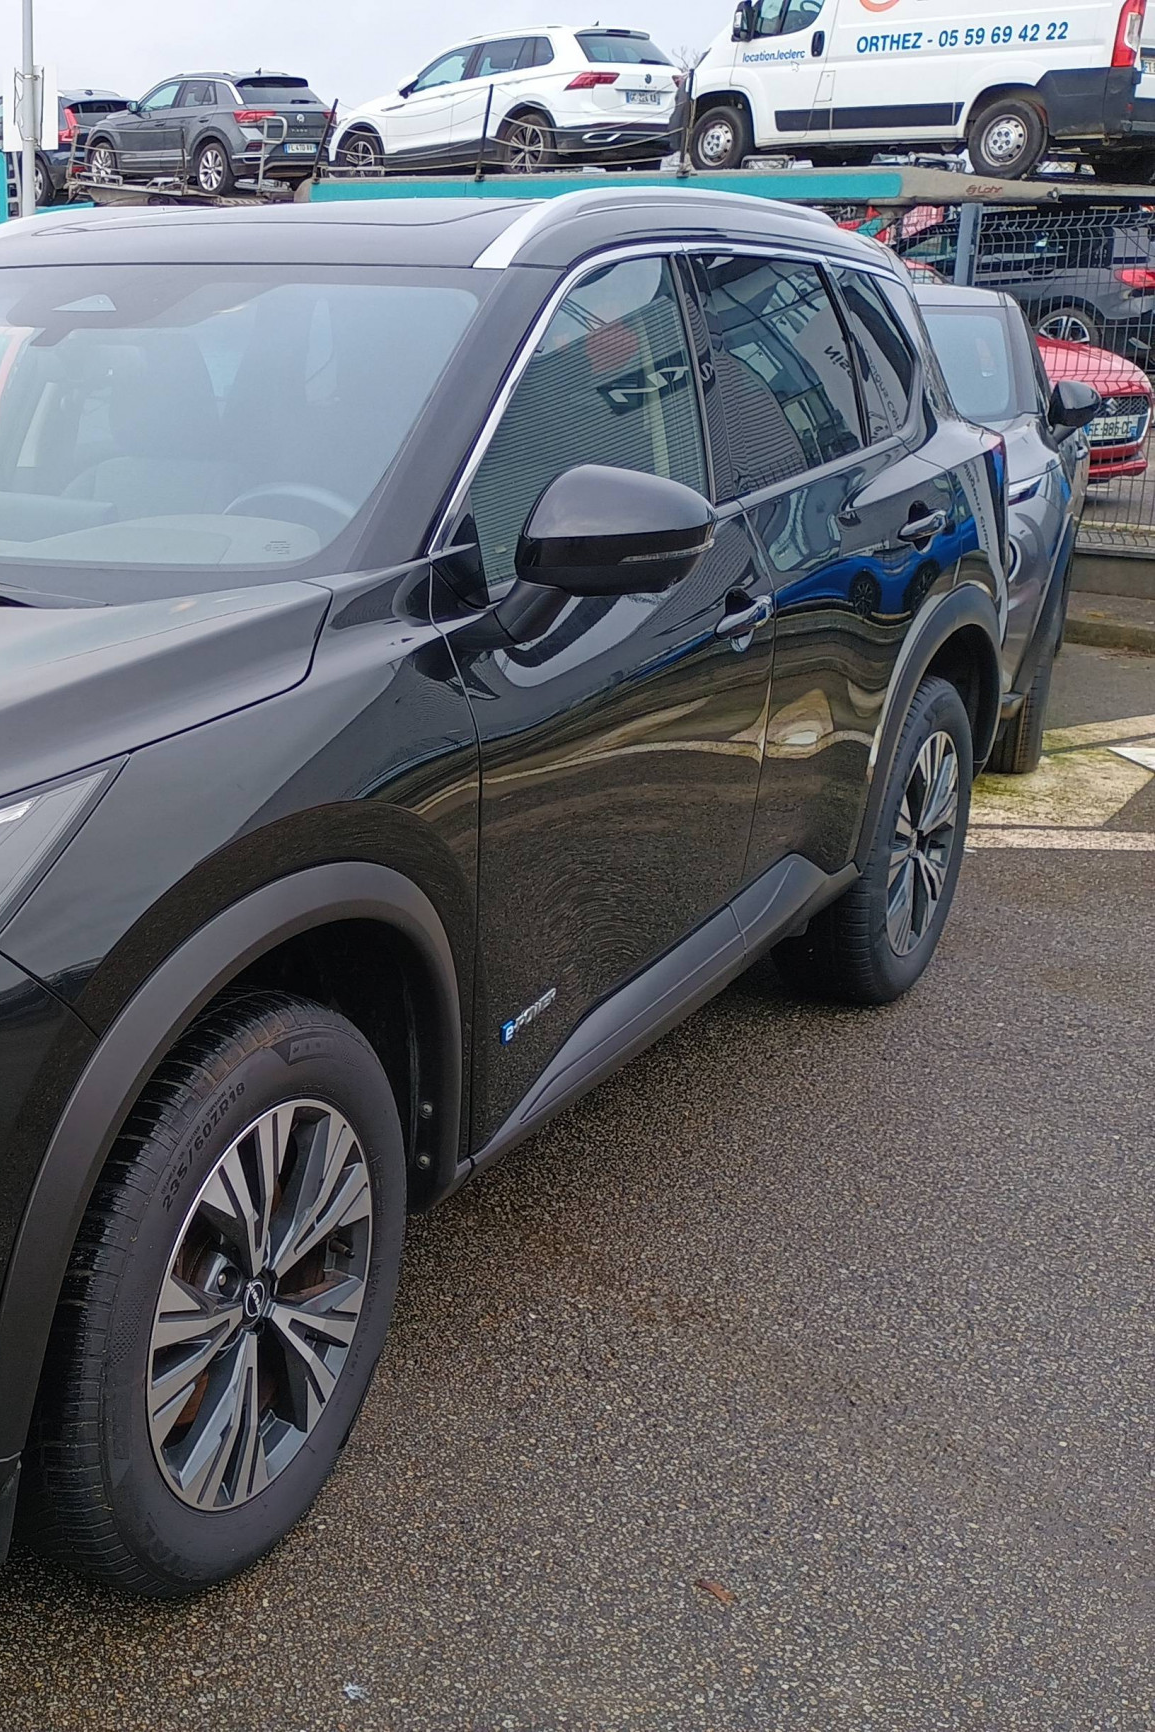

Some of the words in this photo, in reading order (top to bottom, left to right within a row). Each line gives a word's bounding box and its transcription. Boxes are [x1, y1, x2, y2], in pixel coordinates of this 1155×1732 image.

[856, 32, 923, 53] ORTHEZ
[939, 30, 958, 47] 05
[964, 28, 985, 45] 59
[991, 26, 1012, 44] 69
[1018, 24, 1040, 42] 42
[1045, 22, 1068, 40] 22
